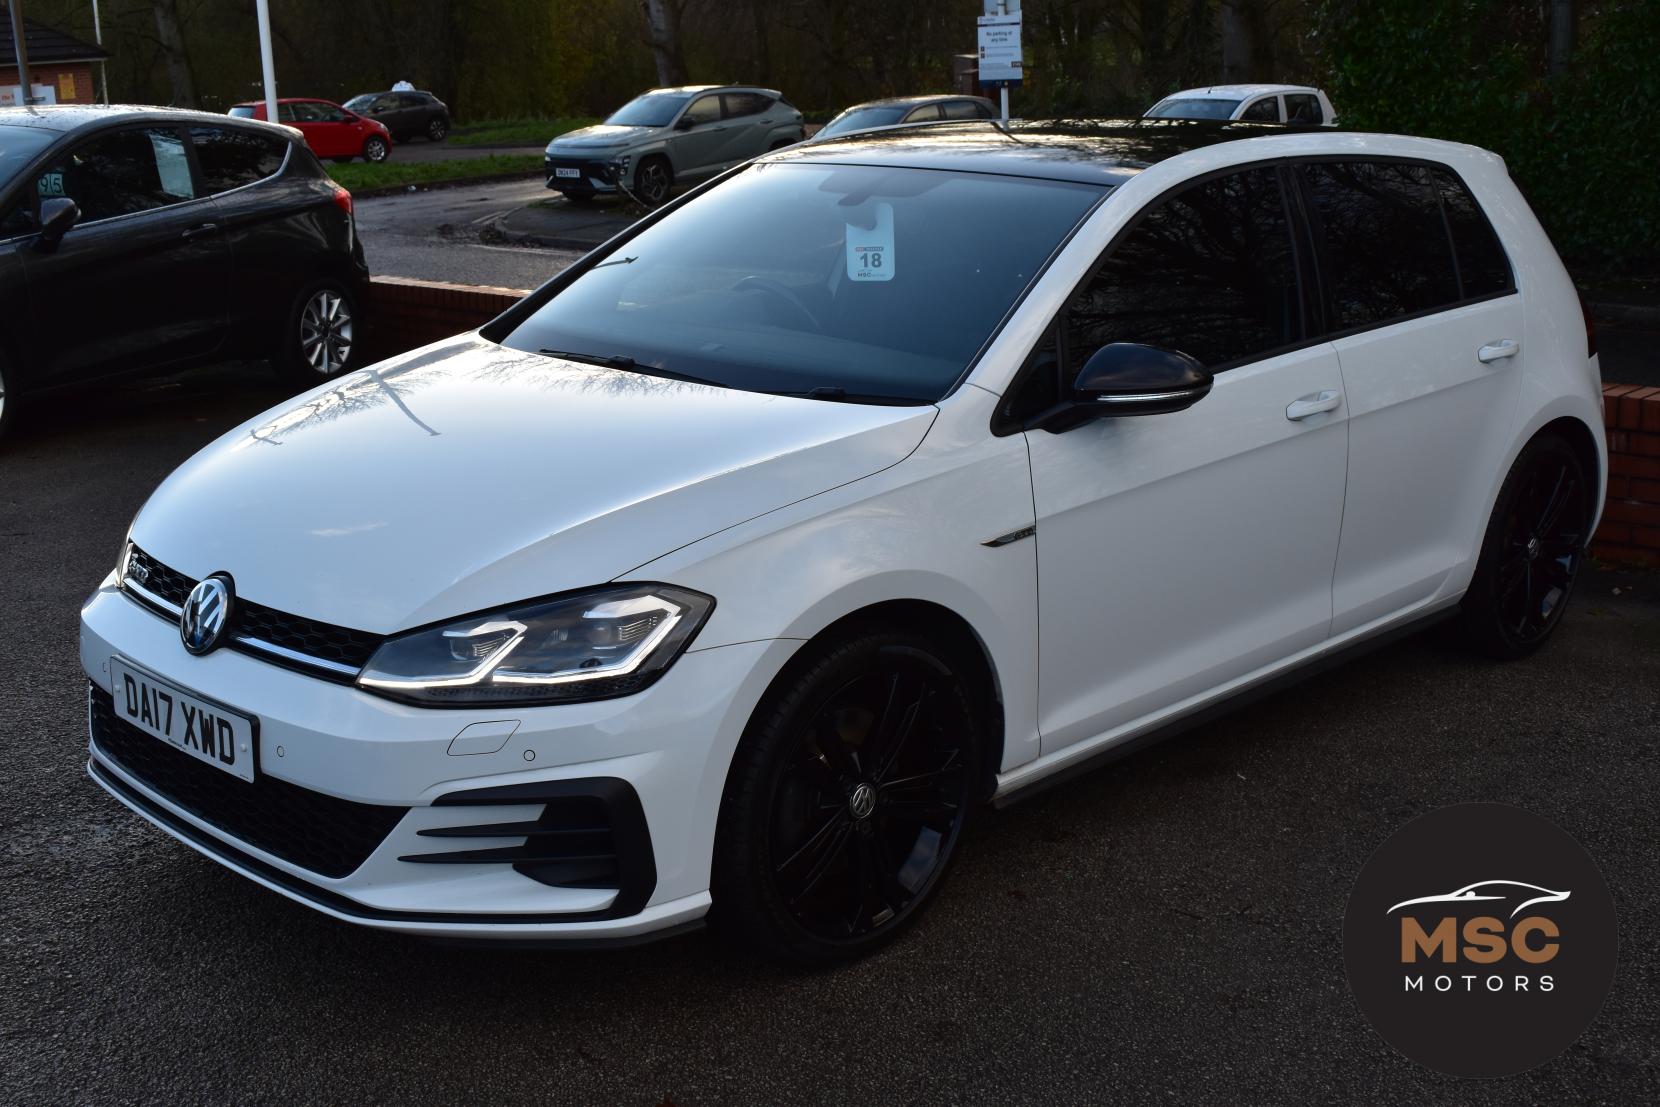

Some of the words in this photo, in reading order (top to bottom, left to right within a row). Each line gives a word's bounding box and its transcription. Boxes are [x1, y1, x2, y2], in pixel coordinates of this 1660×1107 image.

[860, 252, 882, 268] 18
[123, 672, 174, 737] DA17
[180, 700, 236, 766] XWD
